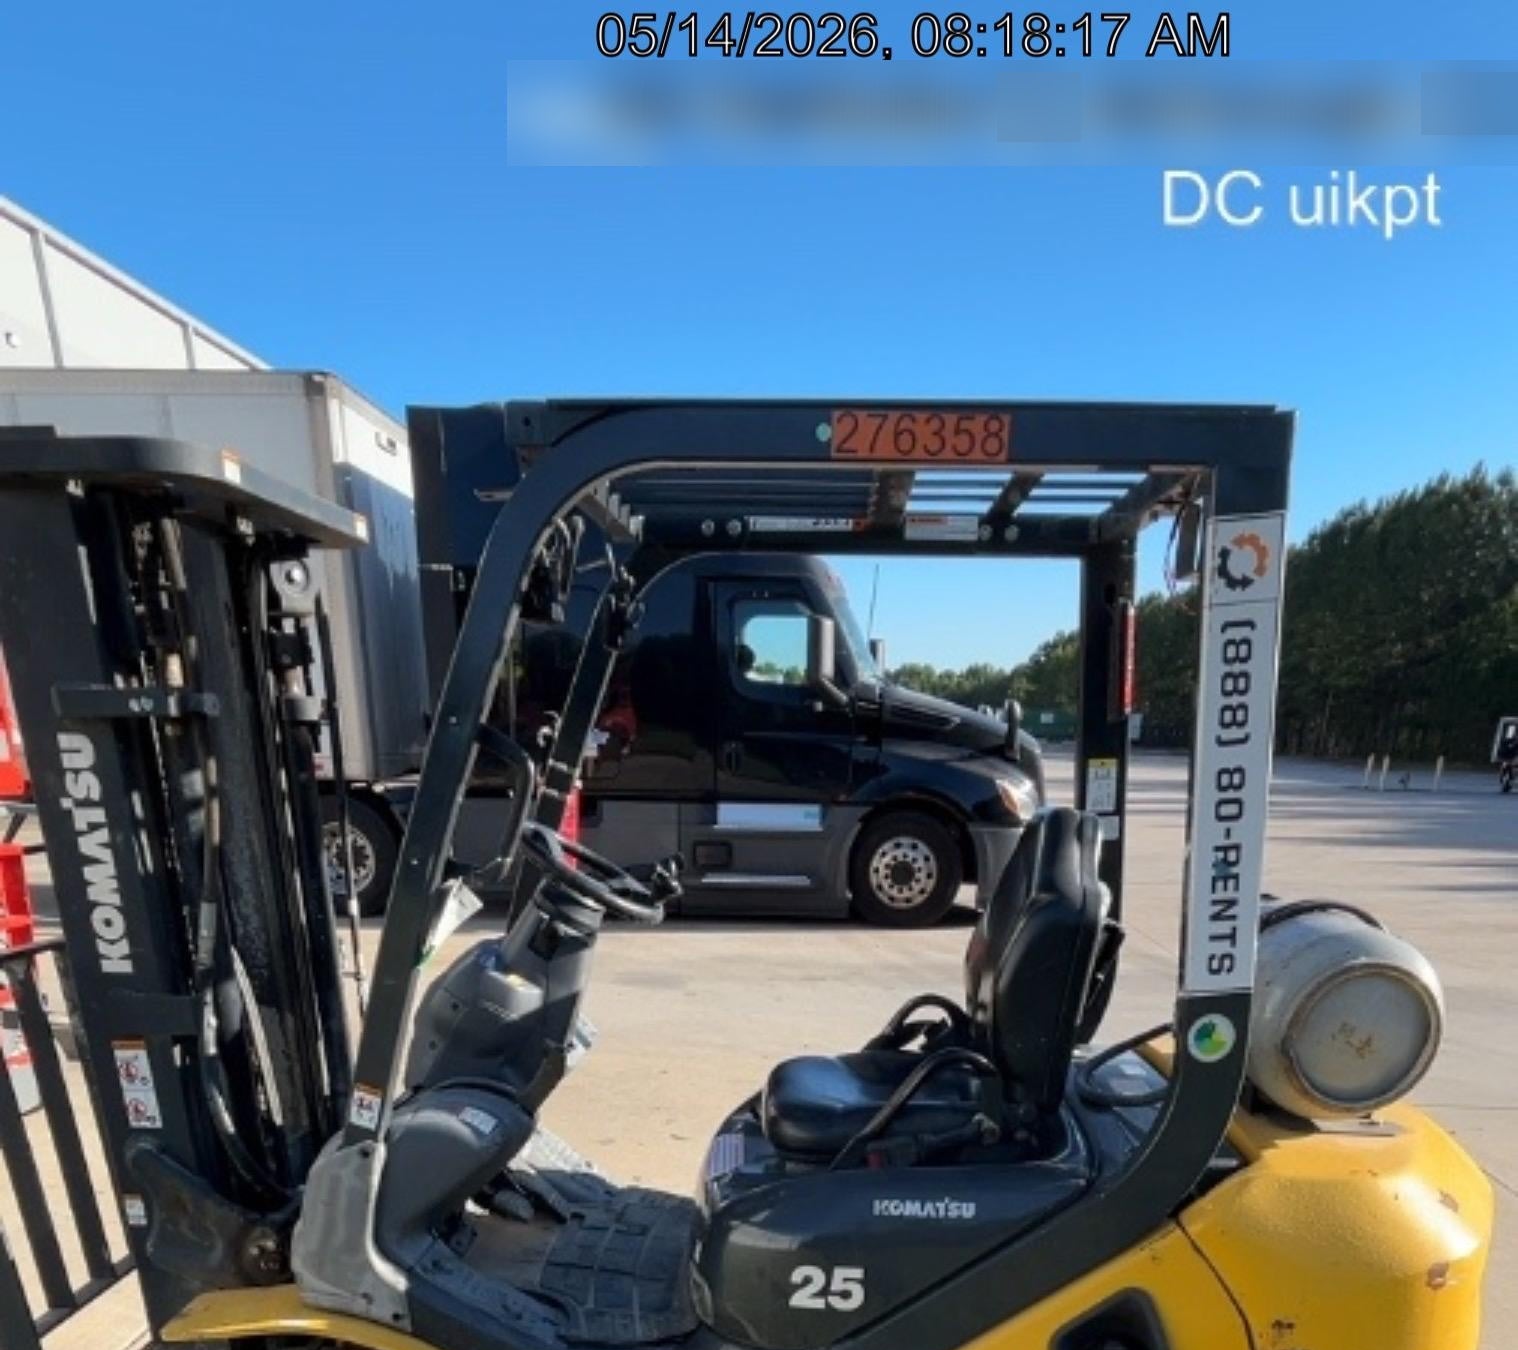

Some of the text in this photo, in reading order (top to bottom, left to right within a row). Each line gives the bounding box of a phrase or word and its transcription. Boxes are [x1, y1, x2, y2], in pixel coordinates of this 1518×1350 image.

[835, 411, 1006, 456] 276358
[1206, 619, 1256, 976] (888) 80-RENTS
[56, 732, 134, 973] KOMATSU
[871, 1197, 976, 1219] KOMATSU
[788, 1264, 865, 1312] 25
